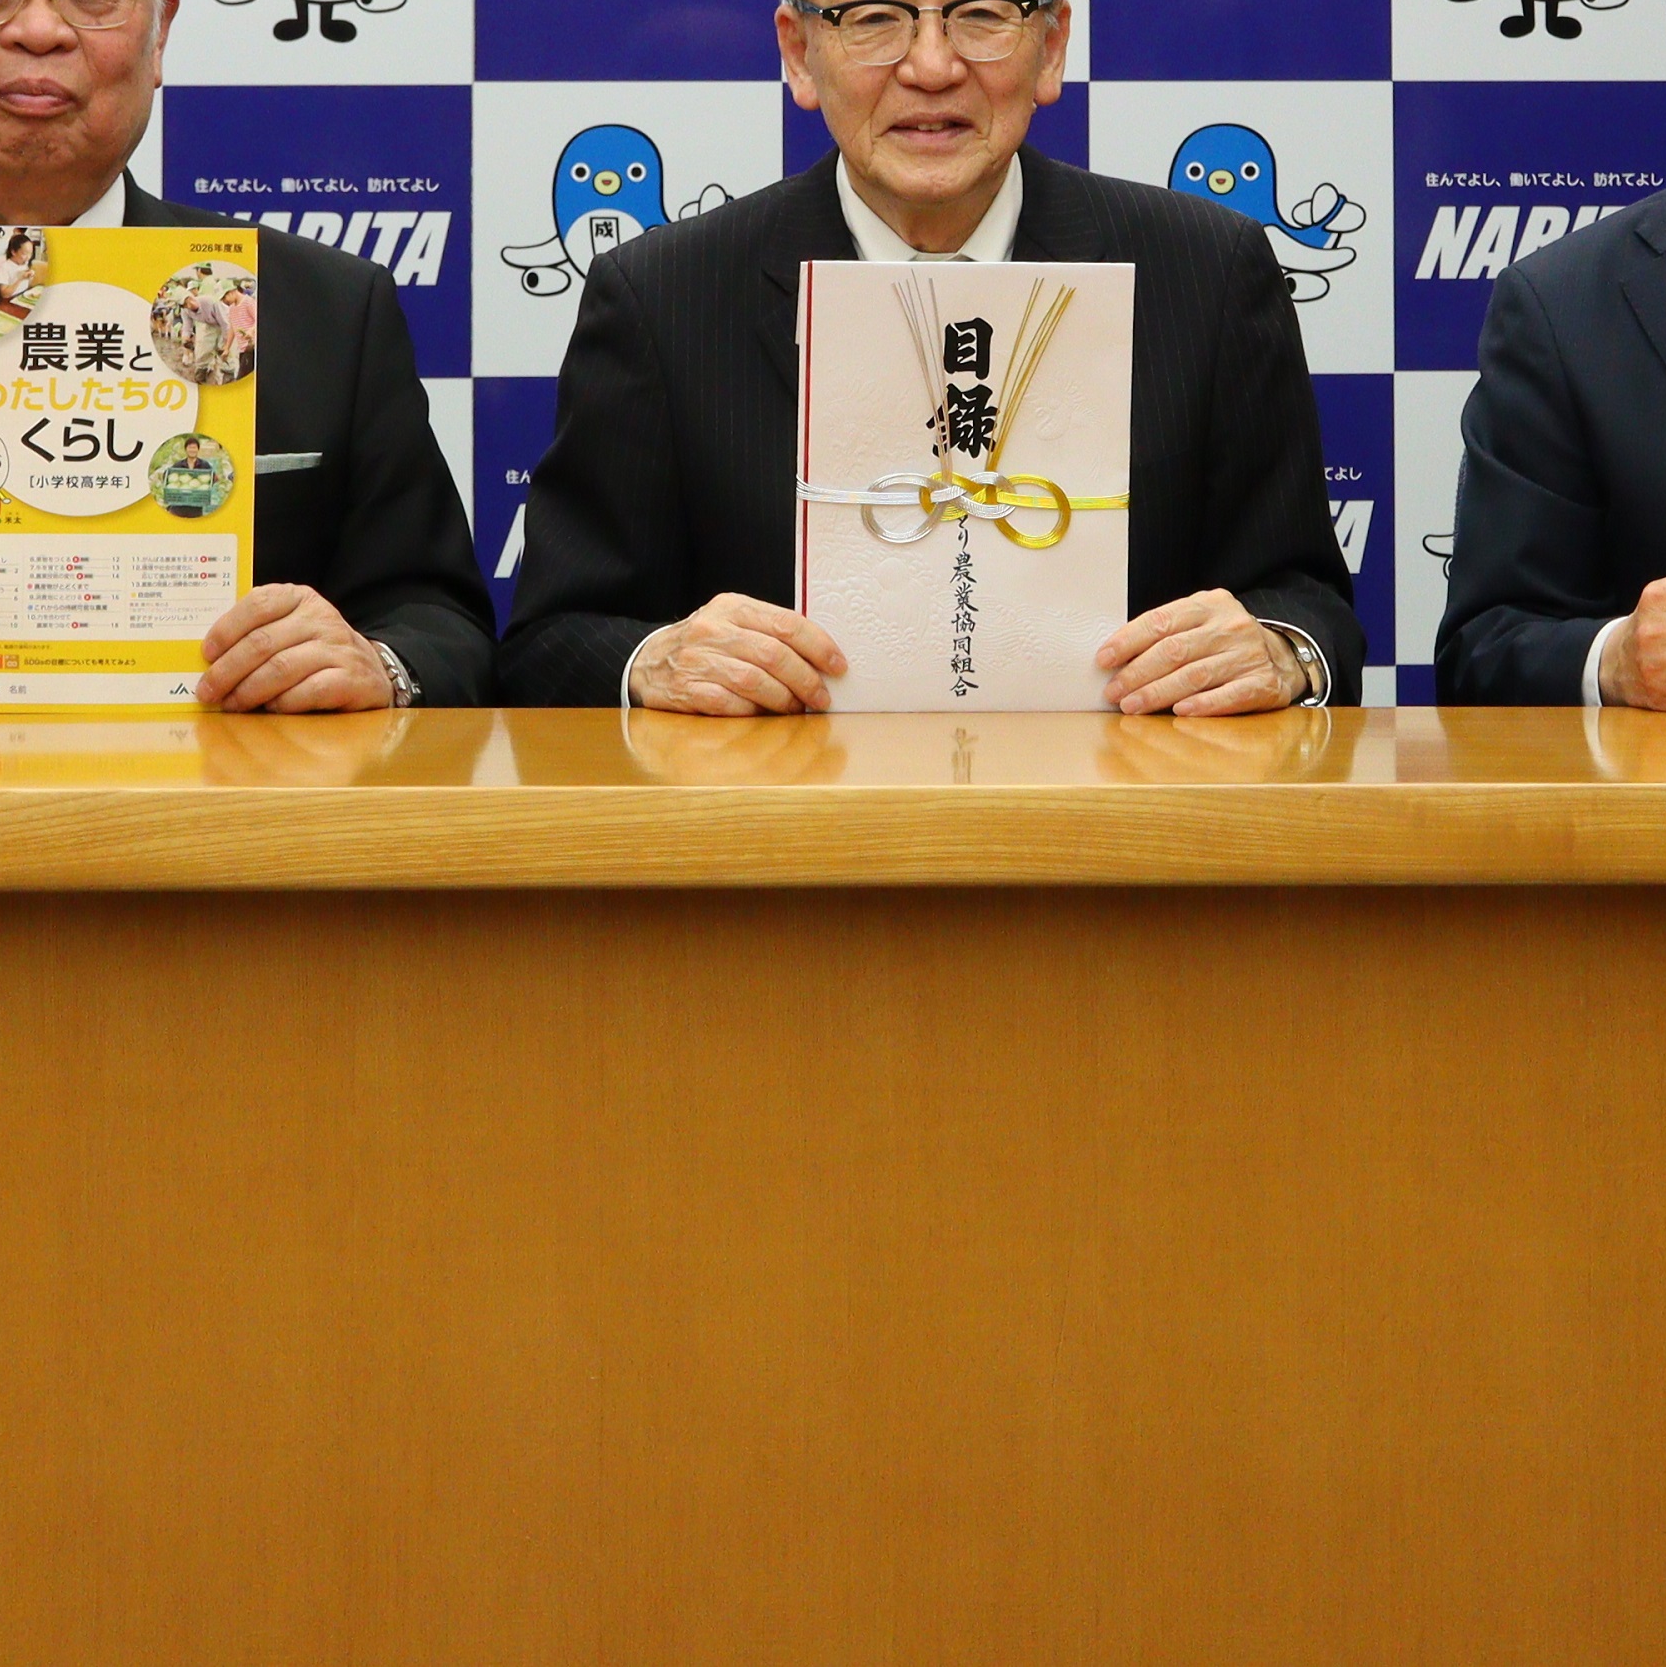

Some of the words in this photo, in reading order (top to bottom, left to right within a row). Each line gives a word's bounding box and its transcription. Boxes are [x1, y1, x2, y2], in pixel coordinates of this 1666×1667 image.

[193, 177, 440, 194] 住んでよし、働いてよし、訪れてよし
[1424, 172, 1664, 188] 住んでよし、働いてよし、訪れてよし
[189, 243, 244, 254] 2026年度版
[19, 322, 153, 372] 農業と
[926, 317, 1000, 459] 目録
[21, 417, 144, 462] くらし
[9, 685, 27, 694] 名前
